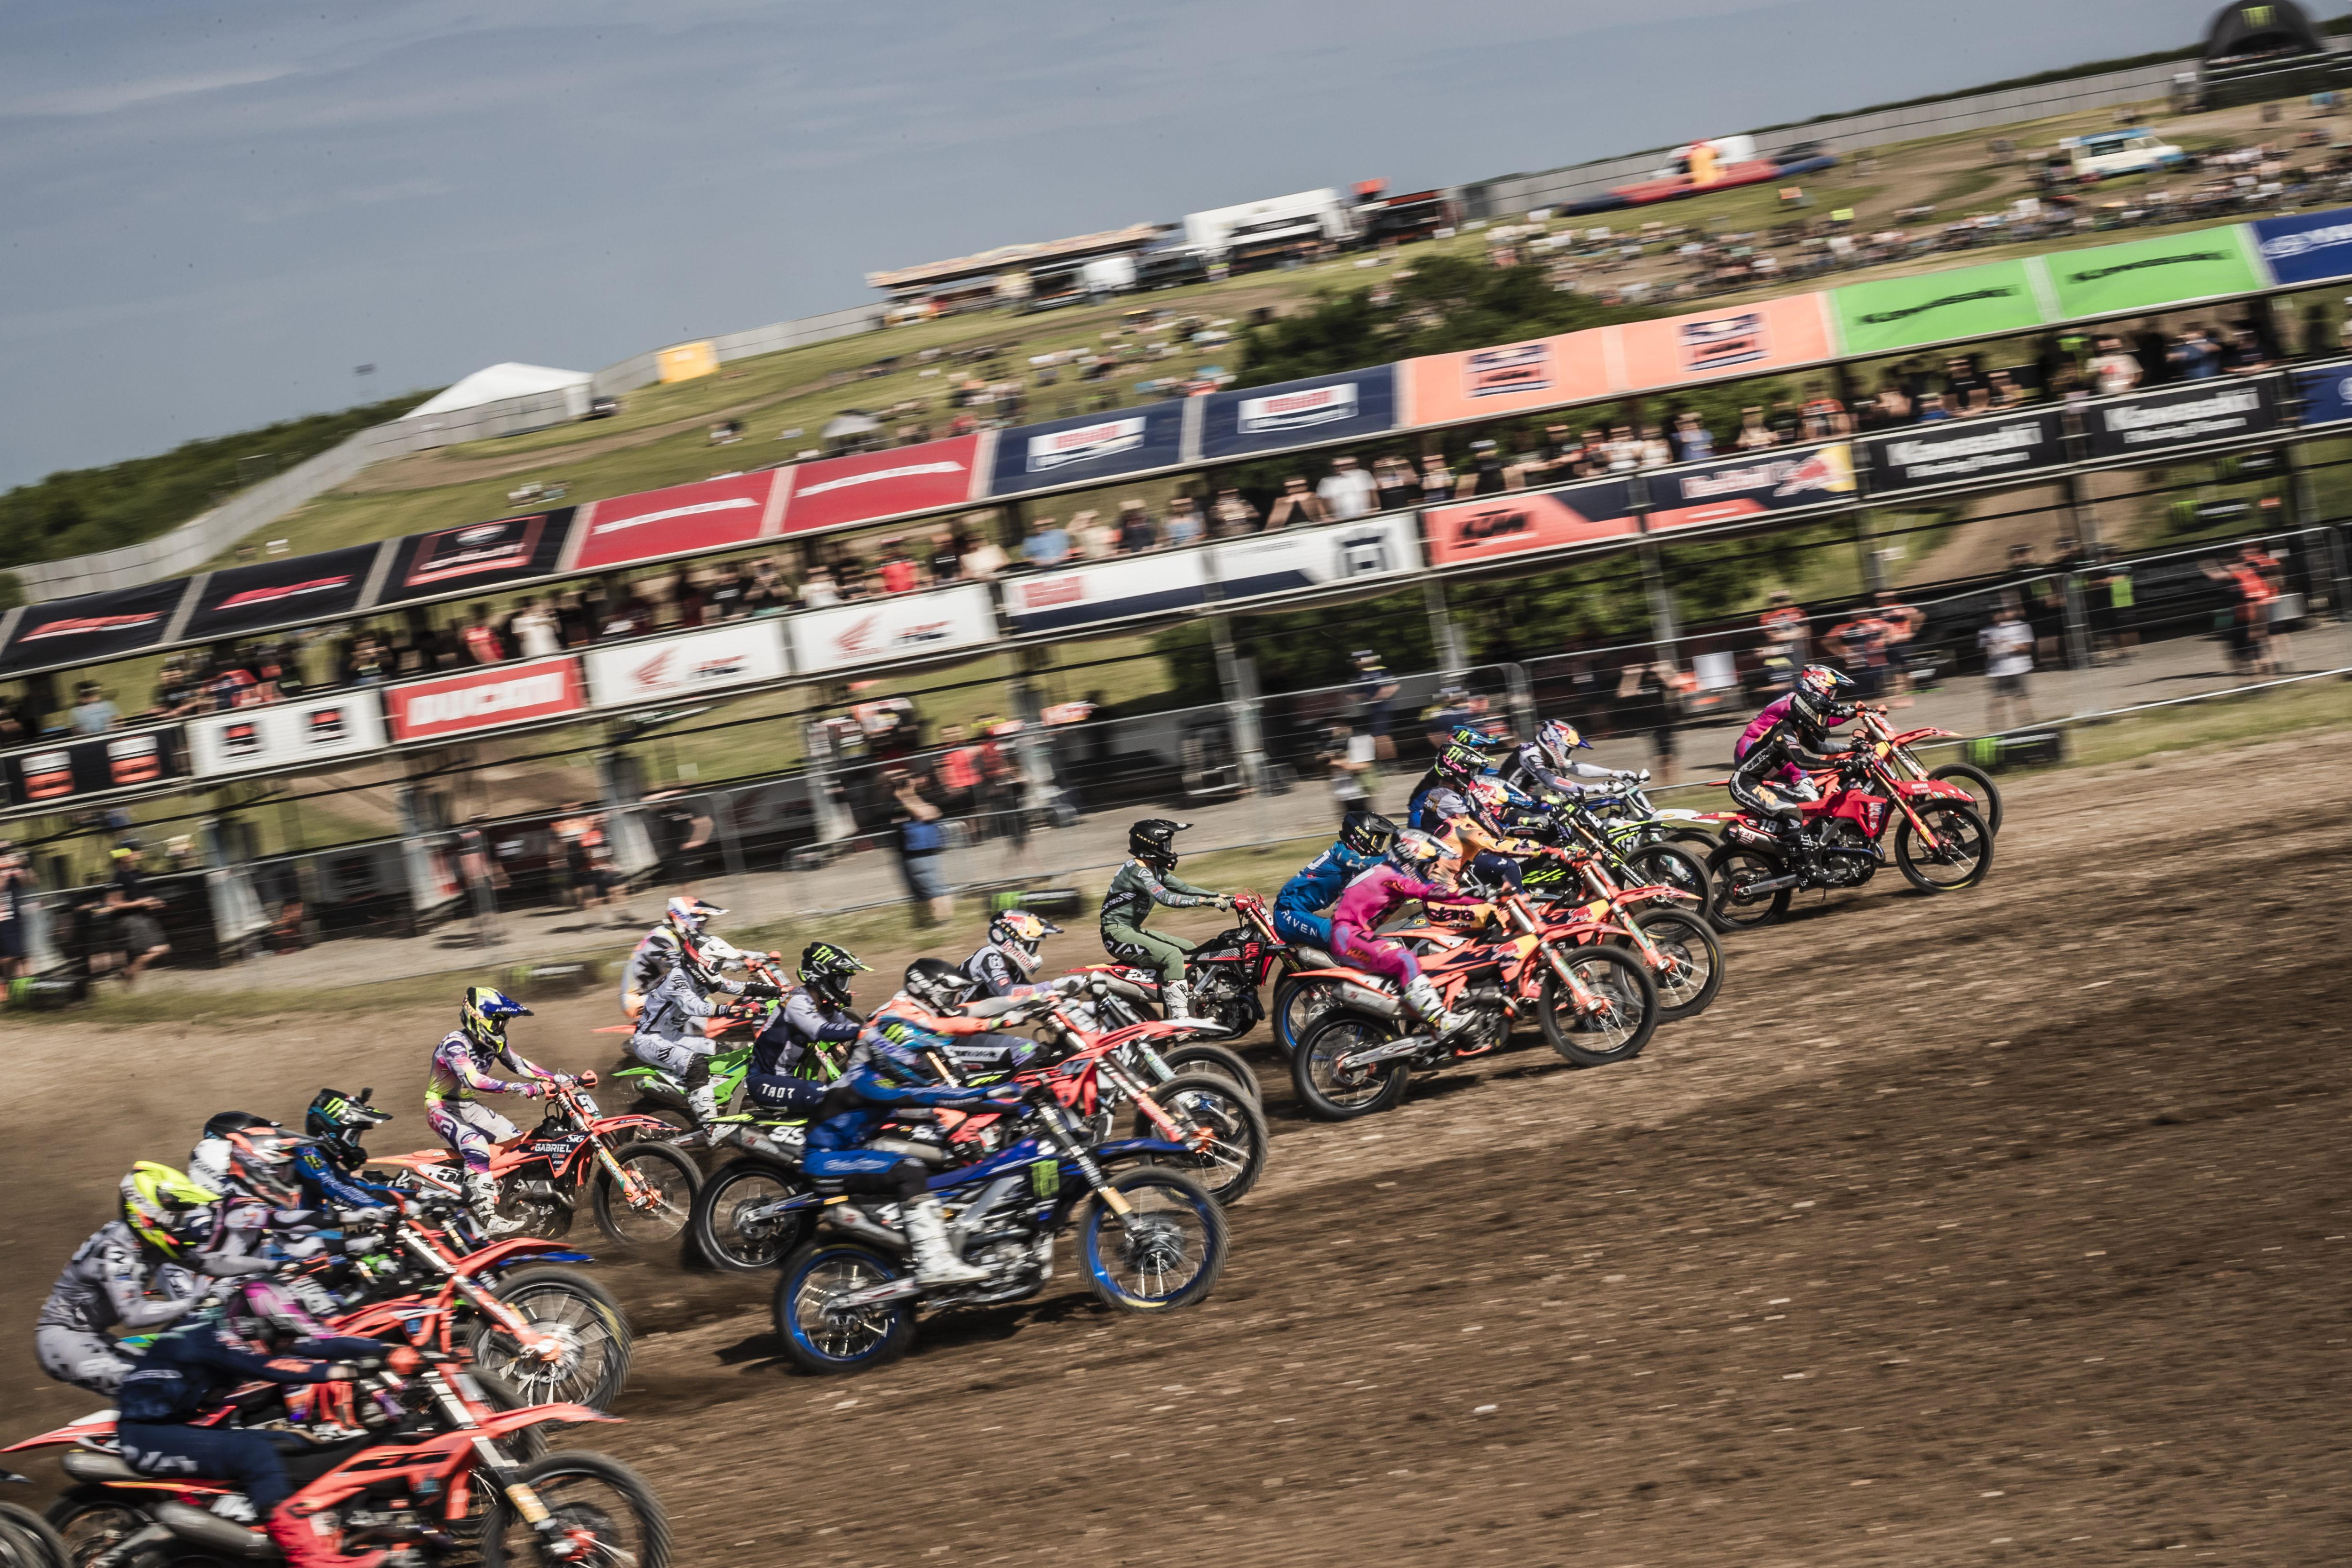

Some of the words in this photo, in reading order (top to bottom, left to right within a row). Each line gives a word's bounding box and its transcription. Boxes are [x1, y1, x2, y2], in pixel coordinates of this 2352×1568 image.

[1804, 706, 1816, 717] FOX
[1354, 825, 1370, 840] RAVEN
[1759, 819, 1778, 833] 18
[1621, 864, 1645, 884] DUNLOP
[1281, 909, 1318, 937] RAVEN
[604, 1159, 625, 1183] MOTOREX
